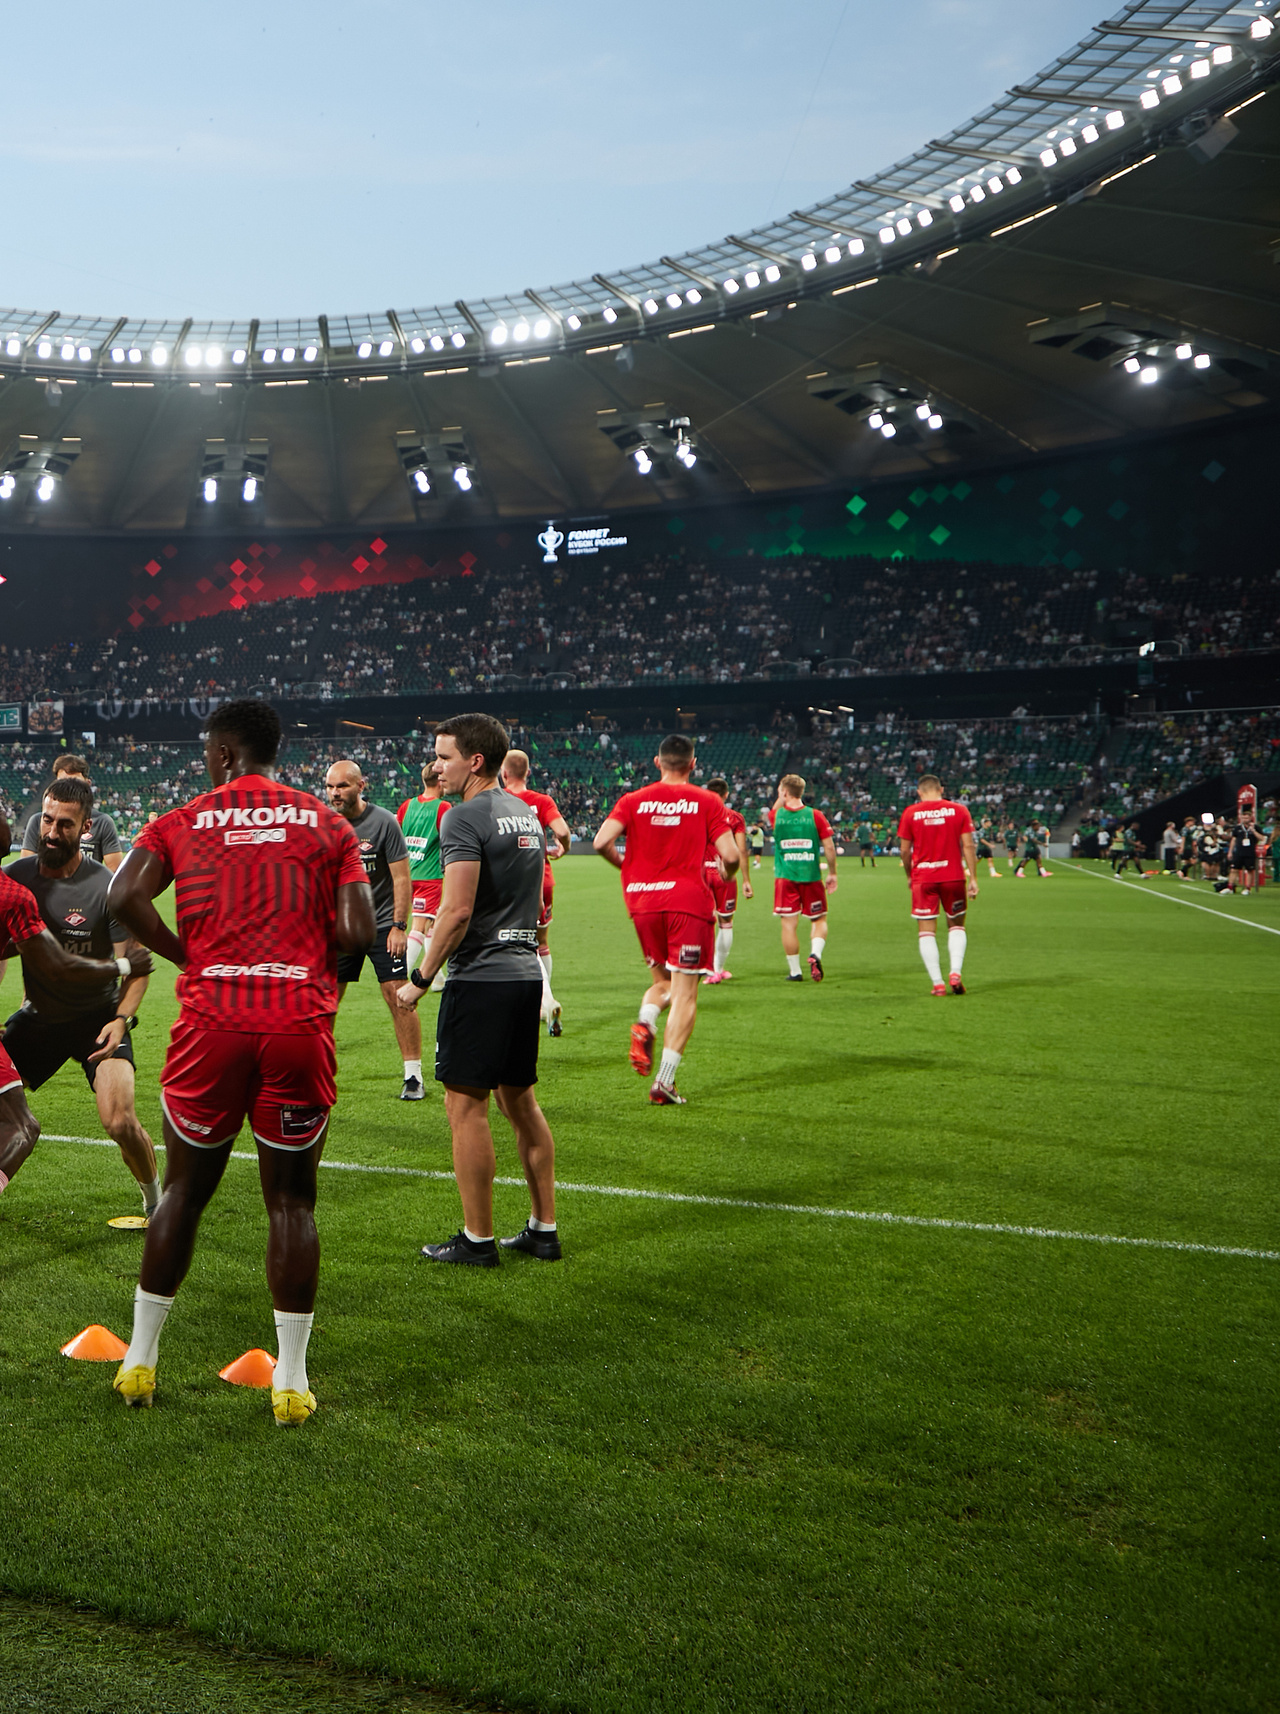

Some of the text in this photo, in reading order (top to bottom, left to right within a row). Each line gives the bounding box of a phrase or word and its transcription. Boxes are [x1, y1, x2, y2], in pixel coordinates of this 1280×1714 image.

[568, 528, 610, 541] FONBET
[636, 799, 699, 815] ЛУКОЙЛ
[913, 807, 956, 820] ЛУКОЙЛ
[191, 804, 318, 829] ЛУКОЙЛ
[626, 881, 677, 893] GENESIS
[201, 963, 309, 979] GENESIS
